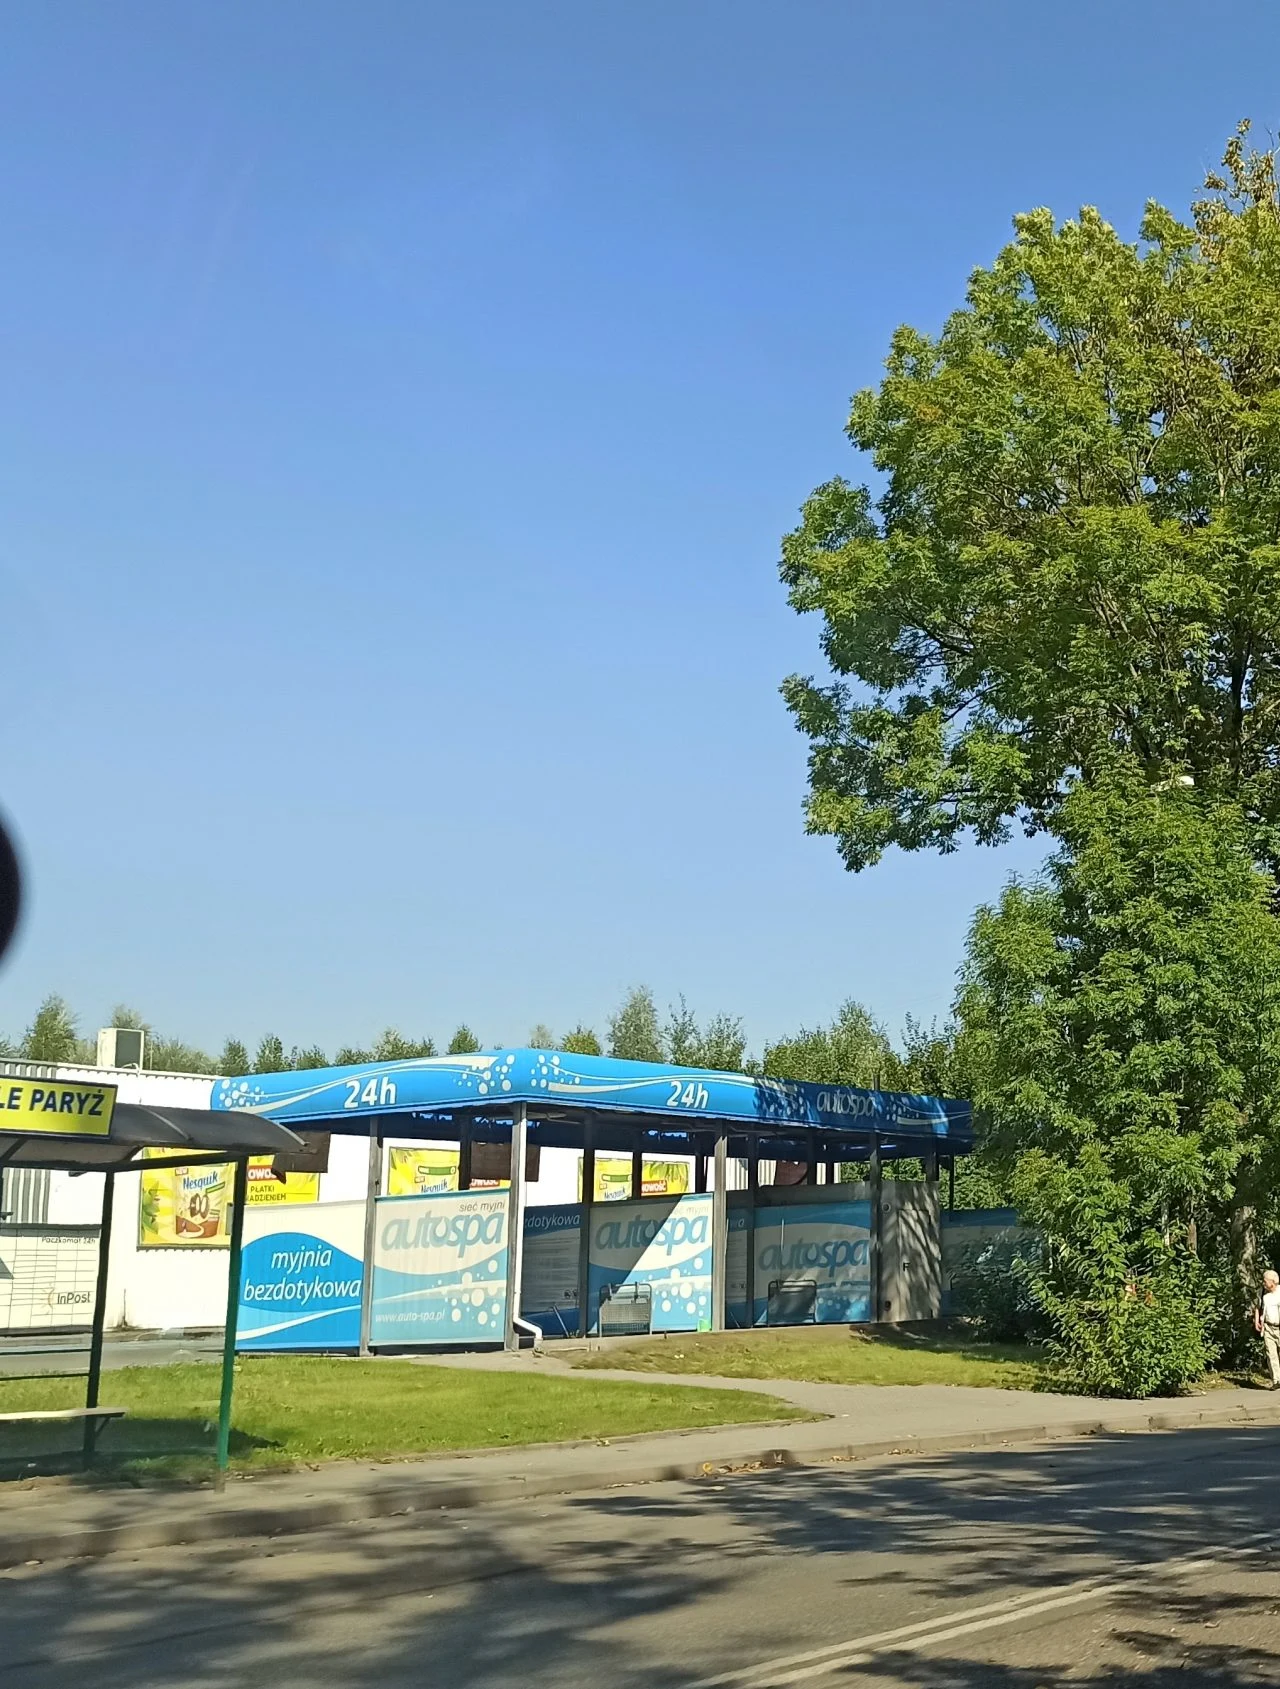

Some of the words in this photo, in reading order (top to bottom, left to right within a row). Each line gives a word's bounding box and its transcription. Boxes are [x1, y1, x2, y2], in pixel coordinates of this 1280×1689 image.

[29, 1088, 105, 1117] PARYŻ
[344, 1076, 397, 1109] 24h
[666, 1080, 709, 1109] 24h
[817, 1089, 876, 1121] autospa
[183, 1171, 218, 1191] Nesquik
[250, 1185, 275, 1193] PŁATKI
[248, 1193, 287, 1202] ADZIENIEM
[459, 1204, 478, 1212] sieć
[480, 1200, 505, 1213] myjni
[382, 1210, 505, 1258] autospa
[525, 1213, 580, 1230] dotykowa
[595, 1215, 709, 1256] autospa
[271, 1245, 332, 1275] myjnia
[758, 1237, 869, 1277] autospa
[57, 1291, 91, 1305] InPost
[243, 1275, 362, 1306] bezdotykowa
[375, 1308, 446, 1323] www.auto-spa.pl
